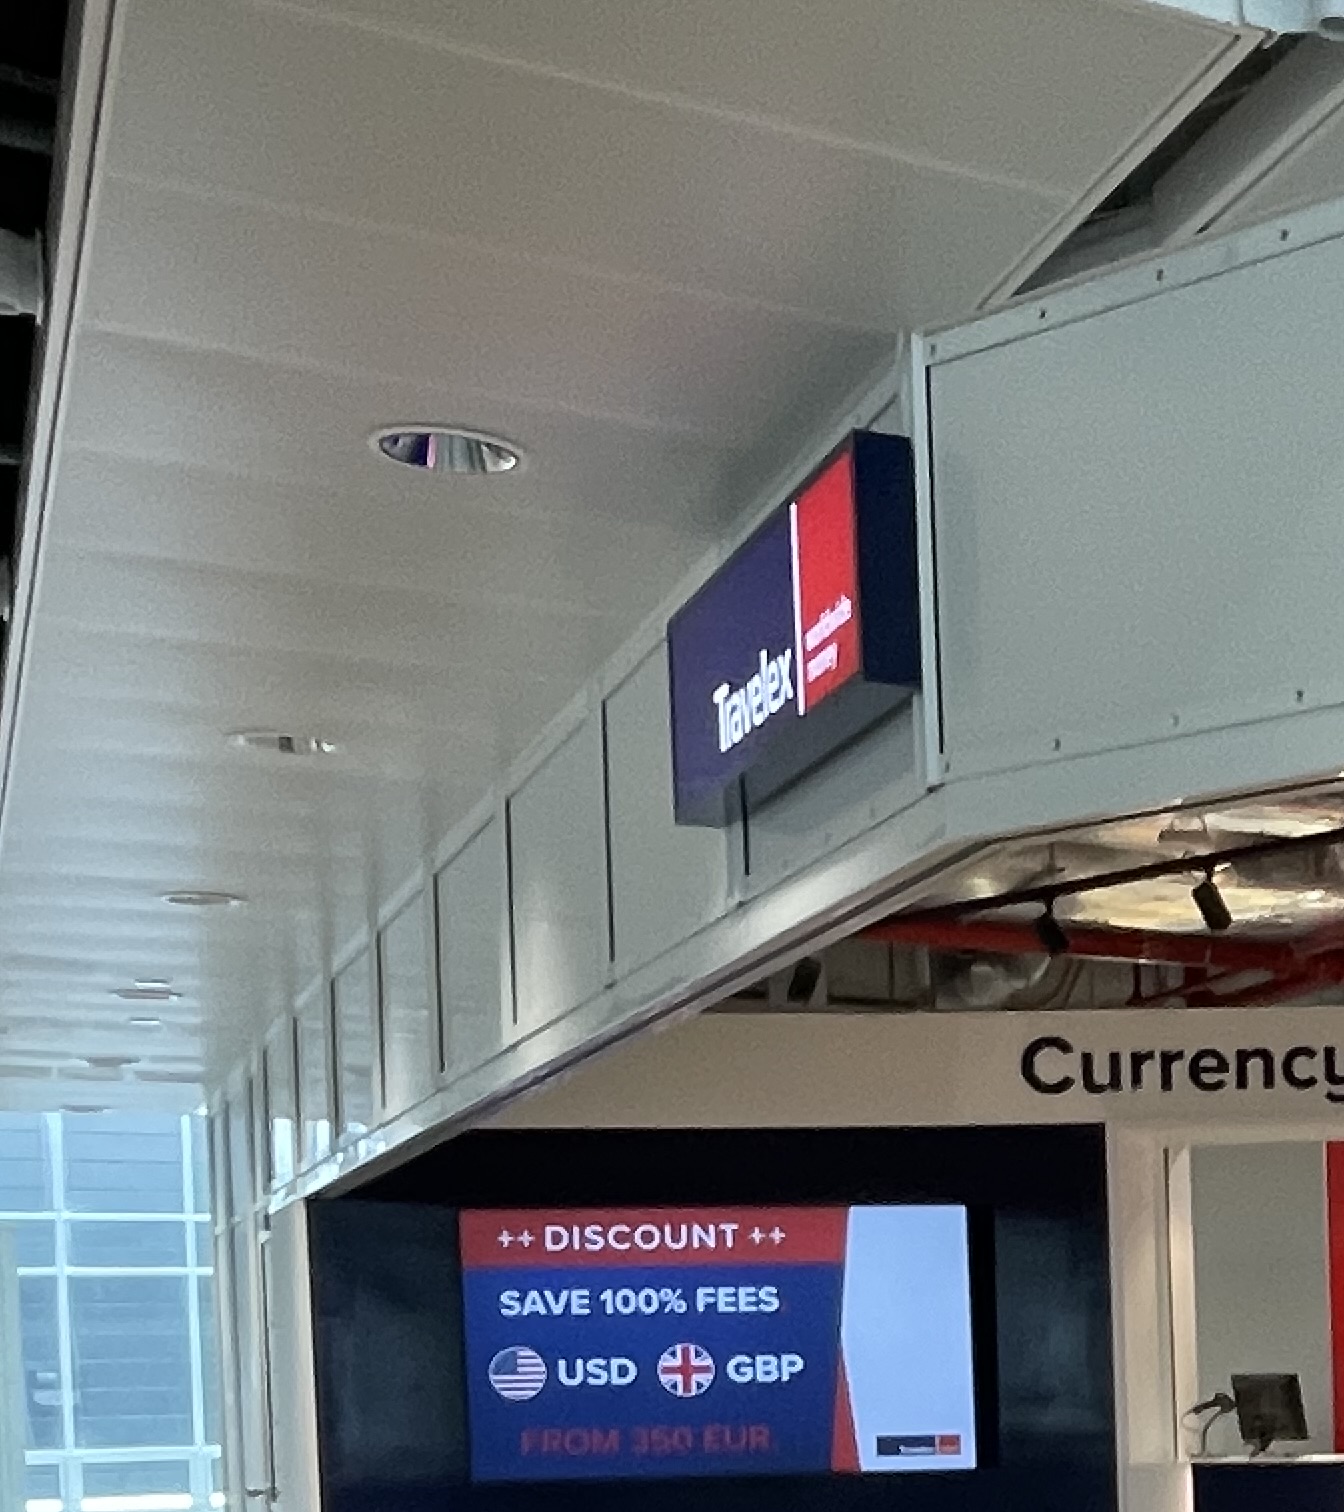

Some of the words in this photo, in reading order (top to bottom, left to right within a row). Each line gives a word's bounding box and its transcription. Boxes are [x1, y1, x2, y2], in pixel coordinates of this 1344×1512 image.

[712, 649, 795, 753] Travelex
[545, 1223, 739, 1252] DISCOUNT
[499, 1290, 591, 1317] SAVE
[599, 1288, 687, 1315] 100%
[697, 1286, 780, 1313] FEES
[558, 1359, 638, 1386] USD
[727, 1355, 804, 1384] GBP
[520, 1428, 621, 1456] FROM
[632, 1427, 693, 1455] 350
[702, 1425, 772, 1452] EUR
